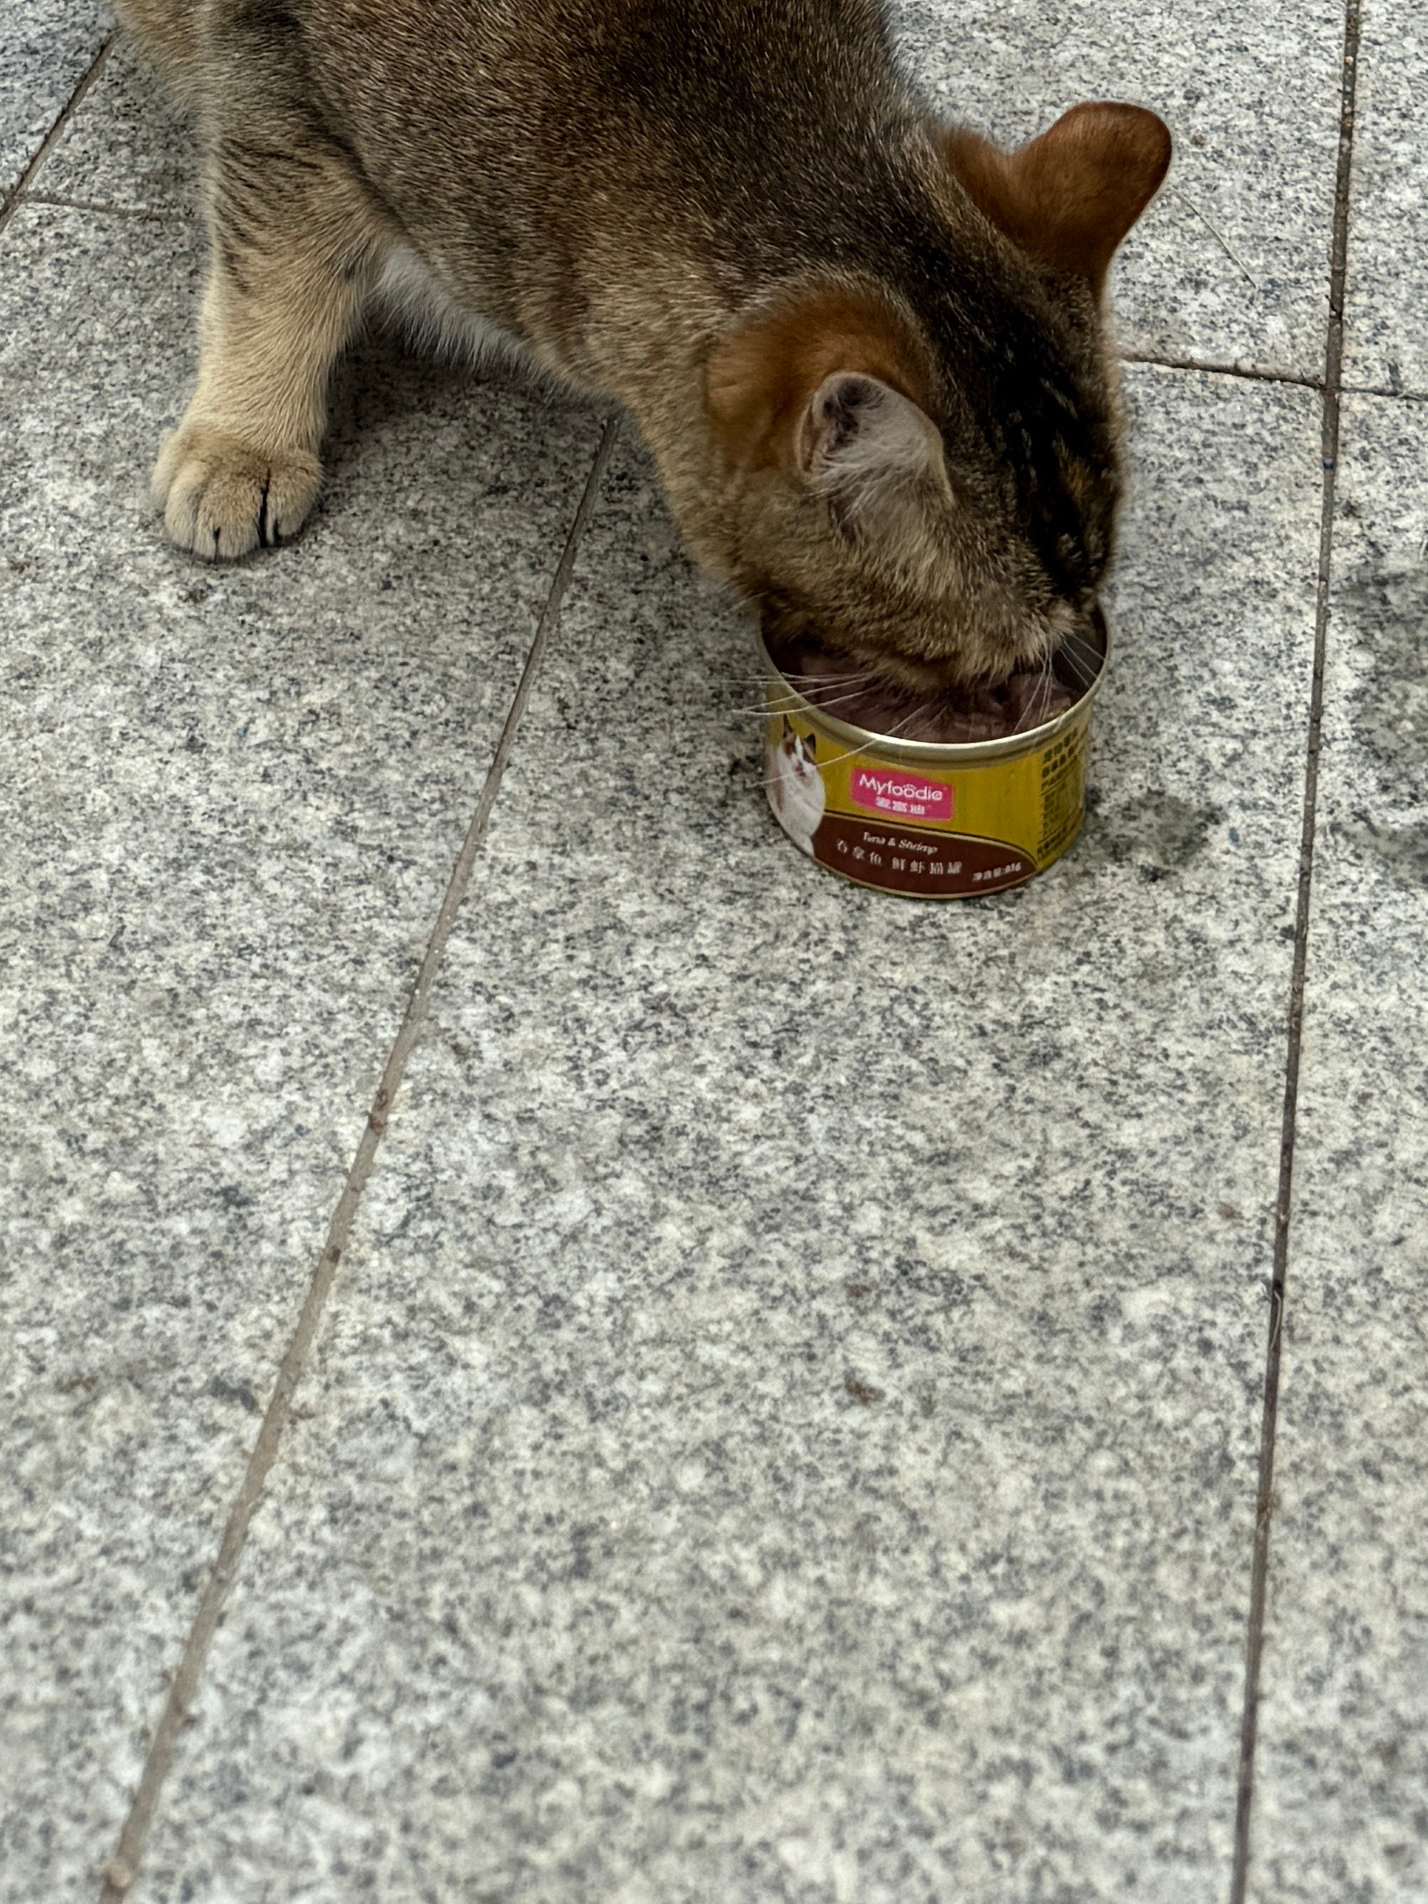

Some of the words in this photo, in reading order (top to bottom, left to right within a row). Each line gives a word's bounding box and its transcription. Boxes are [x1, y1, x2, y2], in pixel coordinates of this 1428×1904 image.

[859, 773, 943, 801] Myfoodie
[887, 837, 896, 847] &
[898, 838, 938, 855] Shrimp
